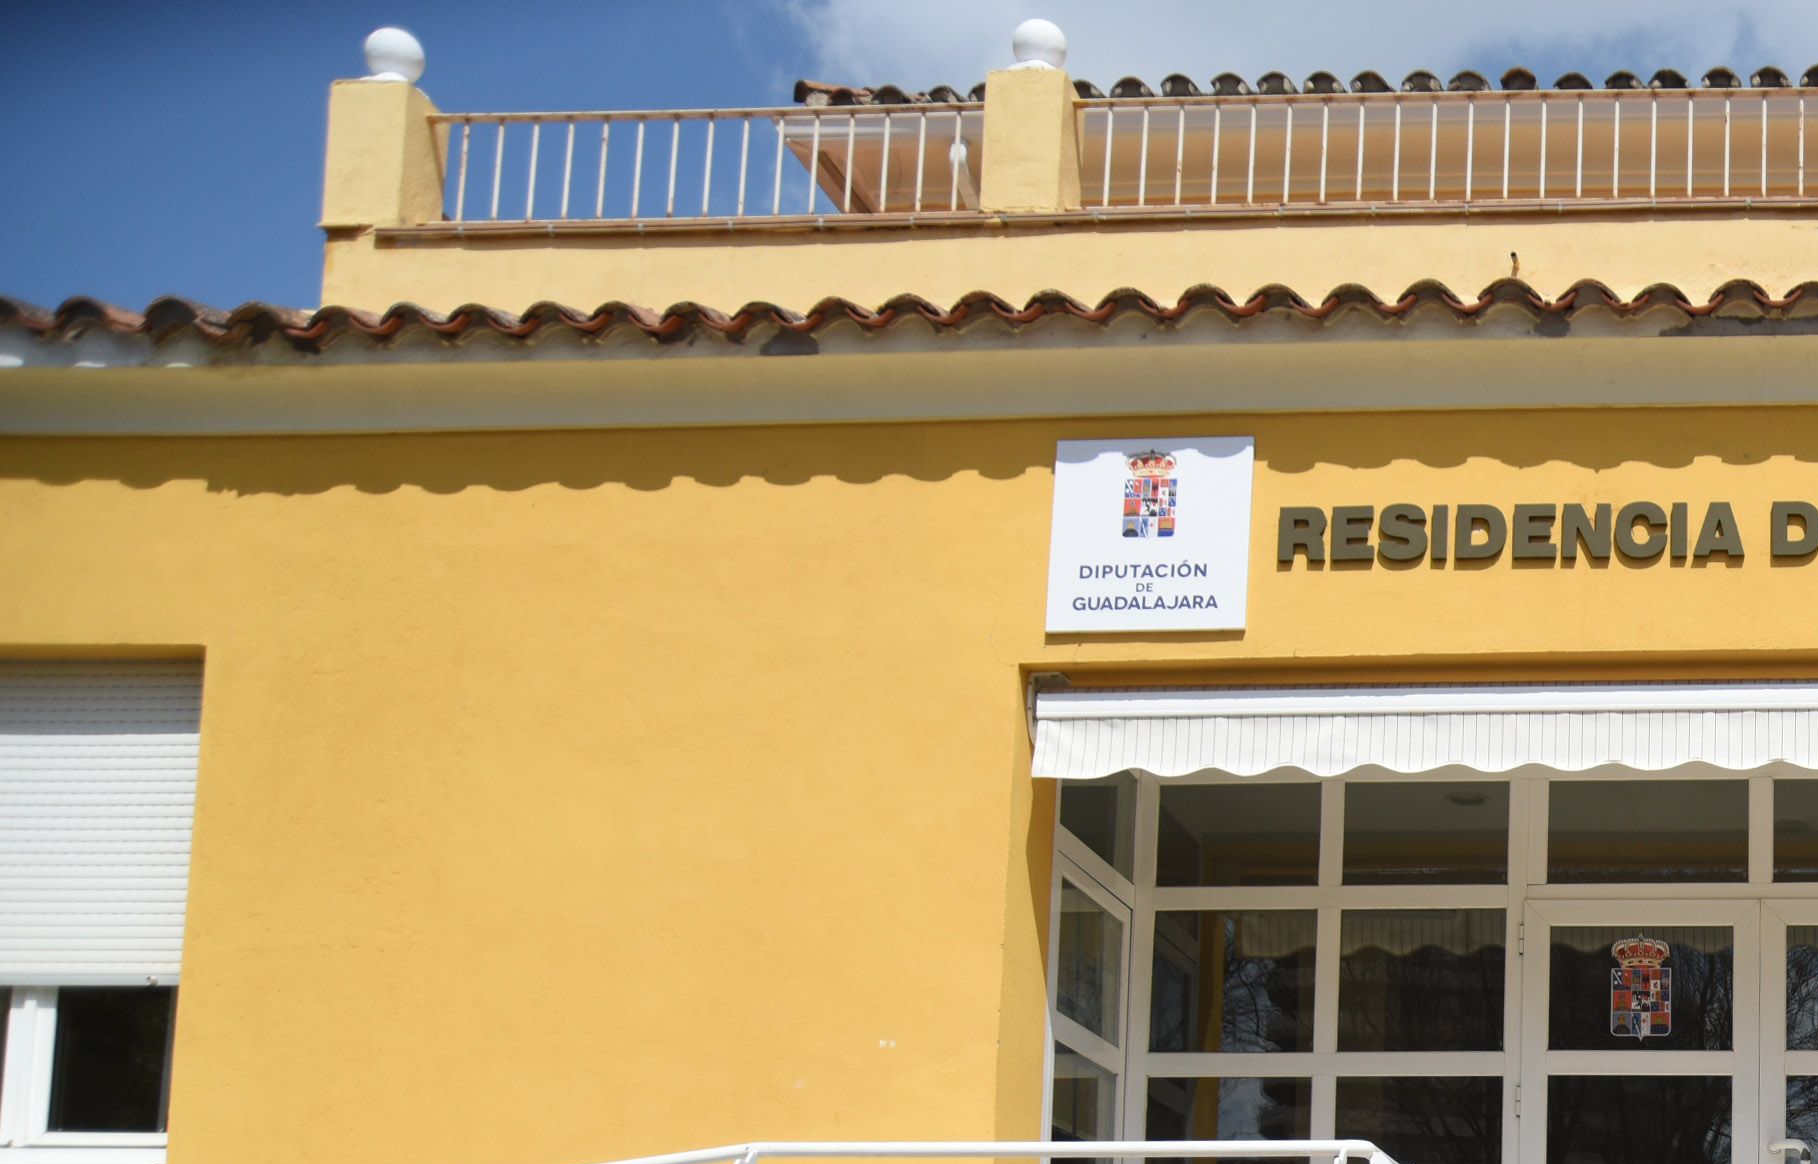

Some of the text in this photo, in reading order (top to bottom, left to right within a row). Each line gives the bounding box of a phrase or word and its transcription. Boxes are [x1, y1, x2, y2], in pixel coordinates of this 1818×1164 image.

[1277, 501, 1745, 563] RESIDENCIA
[1079, 560, 1207, 579] DIPUTACIÓN
[1135, 583, 1153, 592] DE
[1072, 595, 1218, 611] GUADALAJARA
